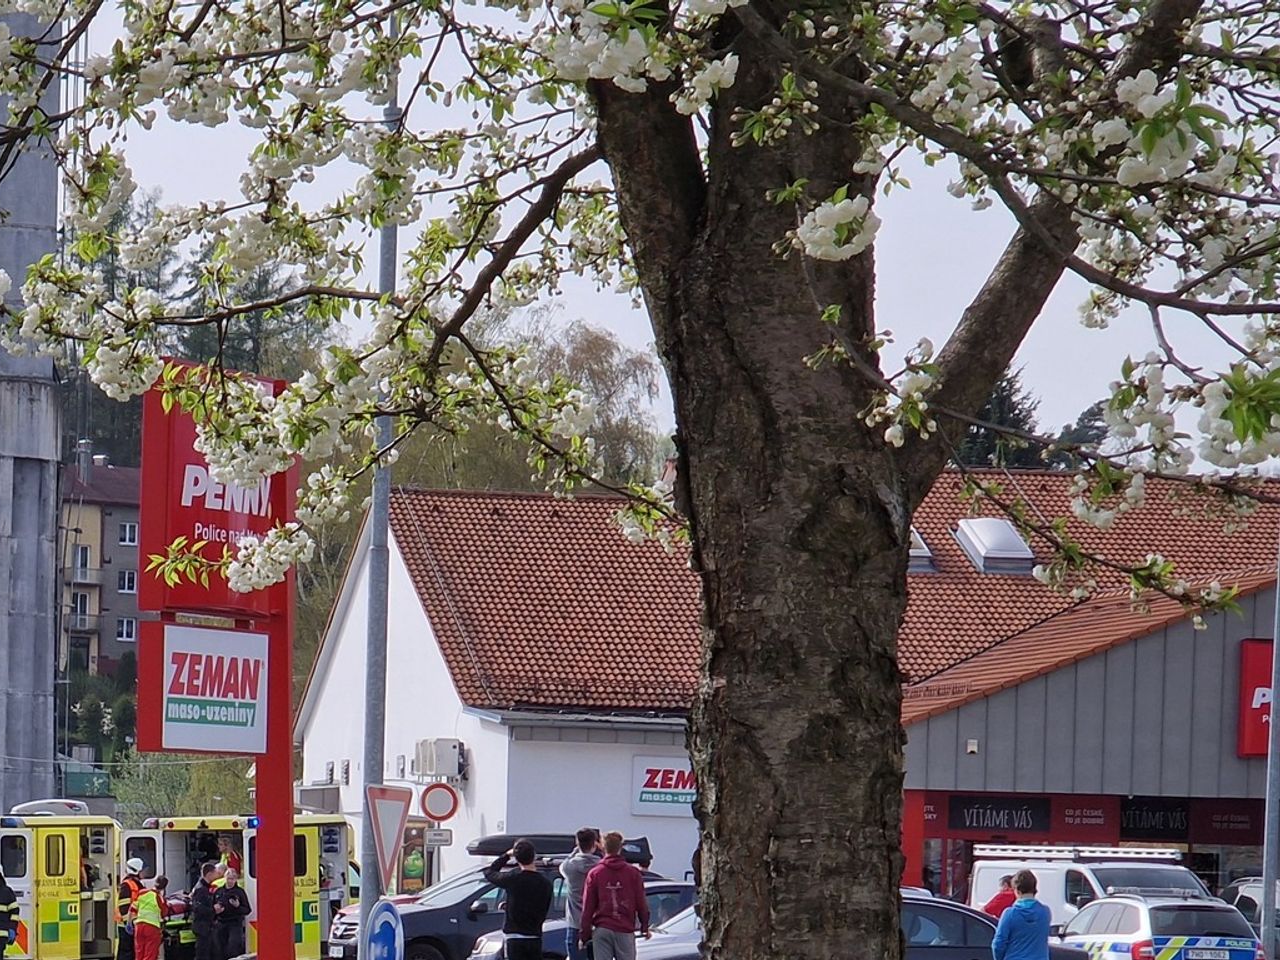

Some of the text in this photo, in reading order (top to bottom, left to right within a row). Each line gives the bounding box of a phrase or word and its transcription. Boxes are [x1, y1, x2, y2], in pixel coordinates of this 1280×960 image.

[181, 464, 271, 517] PENNY
[194, 522, 227, 543] Police
[168, 652, 260, 700] ZEMAN
[643, 769, 696, 789] ZEM
[964, 804, 1033, 829] VÍTÁME VÁS
[1122, 806, 1187, 829] VÍTÁME VÁS
